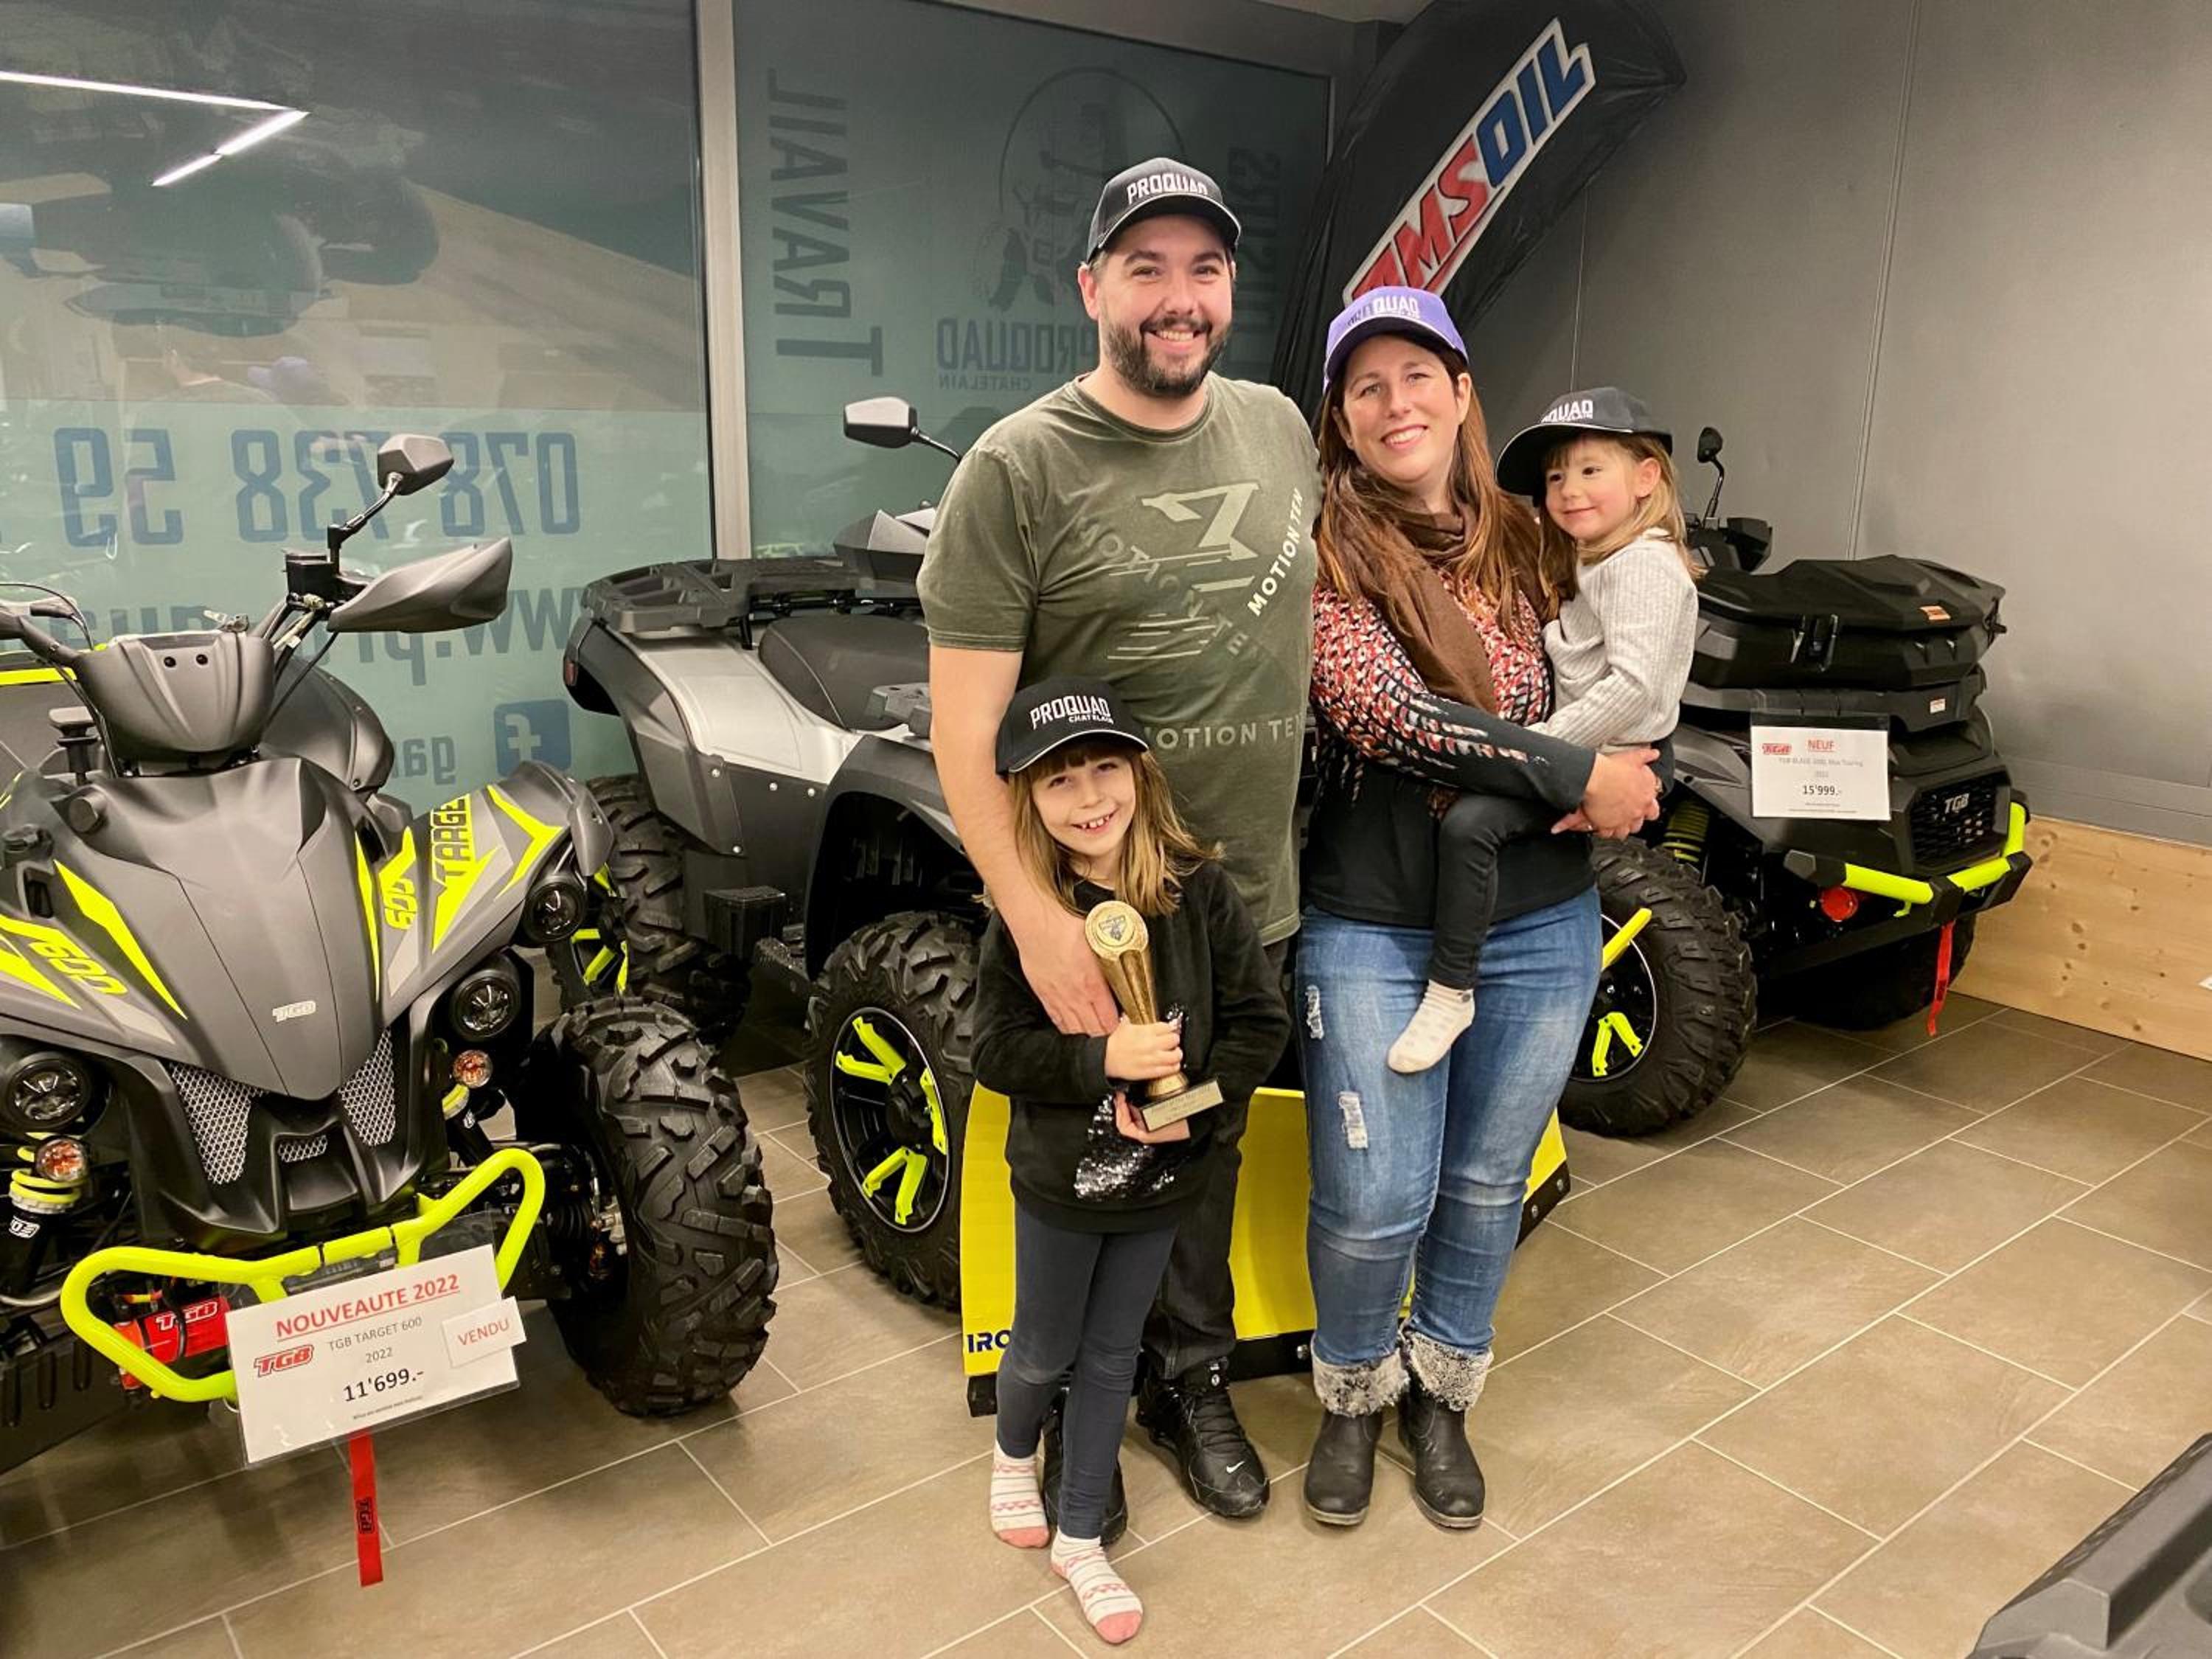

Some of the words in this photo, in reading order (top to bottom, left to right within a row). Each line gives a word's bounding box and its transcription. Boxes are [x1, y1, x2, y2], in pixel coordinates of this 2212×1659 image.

[1349, 27, 1593, 301] AMSOIL
[1127, 173, 1208, 205] PROQUAD
[1247, 525, 1300, 617] MOTION
[1030, 695, 1111, 730] PROQUAD
[1807, 740, 1834, 751] NEUF
[1802, 785, 1842, 796] 15'999.-
[1944, 793, 1970, 815] TGB
[276, 1288, 408, 1338] NOUVEAUTE
[414, 1273, 460, 1301] 2022
[328, 1336, 352, 1352] TGB
[355, 1323, 400, 1344] TARGET
[401, 1316, 423, 1332] 600
[457, 1318, 510, 1346] VENDU
[967, 1329, 1012, 1353] IRO
[254, 1344, 314, 1378] TGB
[366, 1346, 394, 1363] 2022
[343, 1368, 425, 1402] 11'699.-
